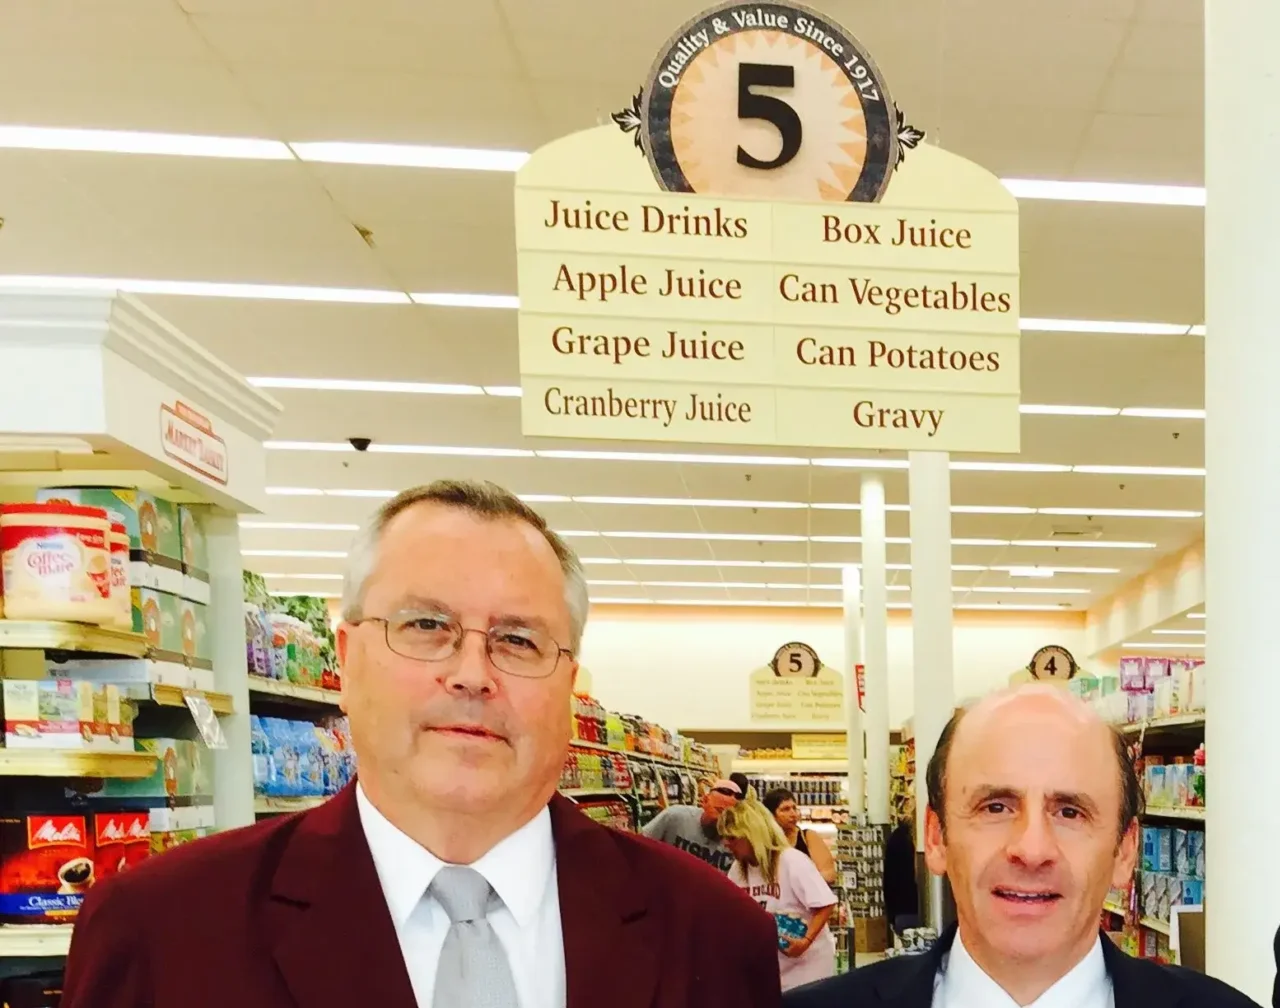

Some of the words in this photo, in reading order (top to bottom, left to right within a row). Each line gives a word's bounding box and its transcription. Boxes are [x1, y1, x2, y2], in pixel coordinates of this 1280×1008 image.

[658, 28, 710, 88] Quality
[711, 17, 730, 35] &
[731, 8, 788, 28] Value
[794, 17, 844, 57] Since
[843, 55, 879, 101] 1917
[737, 63, 803, 171] 5
[545, 201, 630, 233] Juice
[642, 205, 749, 239] Drinks
[823, 215, 881, 246] Box
[892, 219, 972, 250] Juice
[554, 264, 648, 303] Apple
[659, 269, 743, 301] Juice
[779, 274, 840, 305] Can
[851, 278, 1012, 316] Vegetables
[551, 327, 652, 367] Grape
[662, 331, 745, 362] Juice
[796, 338, 857, 368] Can
[869, 340, 1001, 373] Potatoes
[544, 387, 679, 429] Cranberry
[685, 394, 752, 424] Juice
[853, 401, 945, 438] Gravy
[789, 653, 803, 672] 5
[1044, 656, 1057, 675] 4
